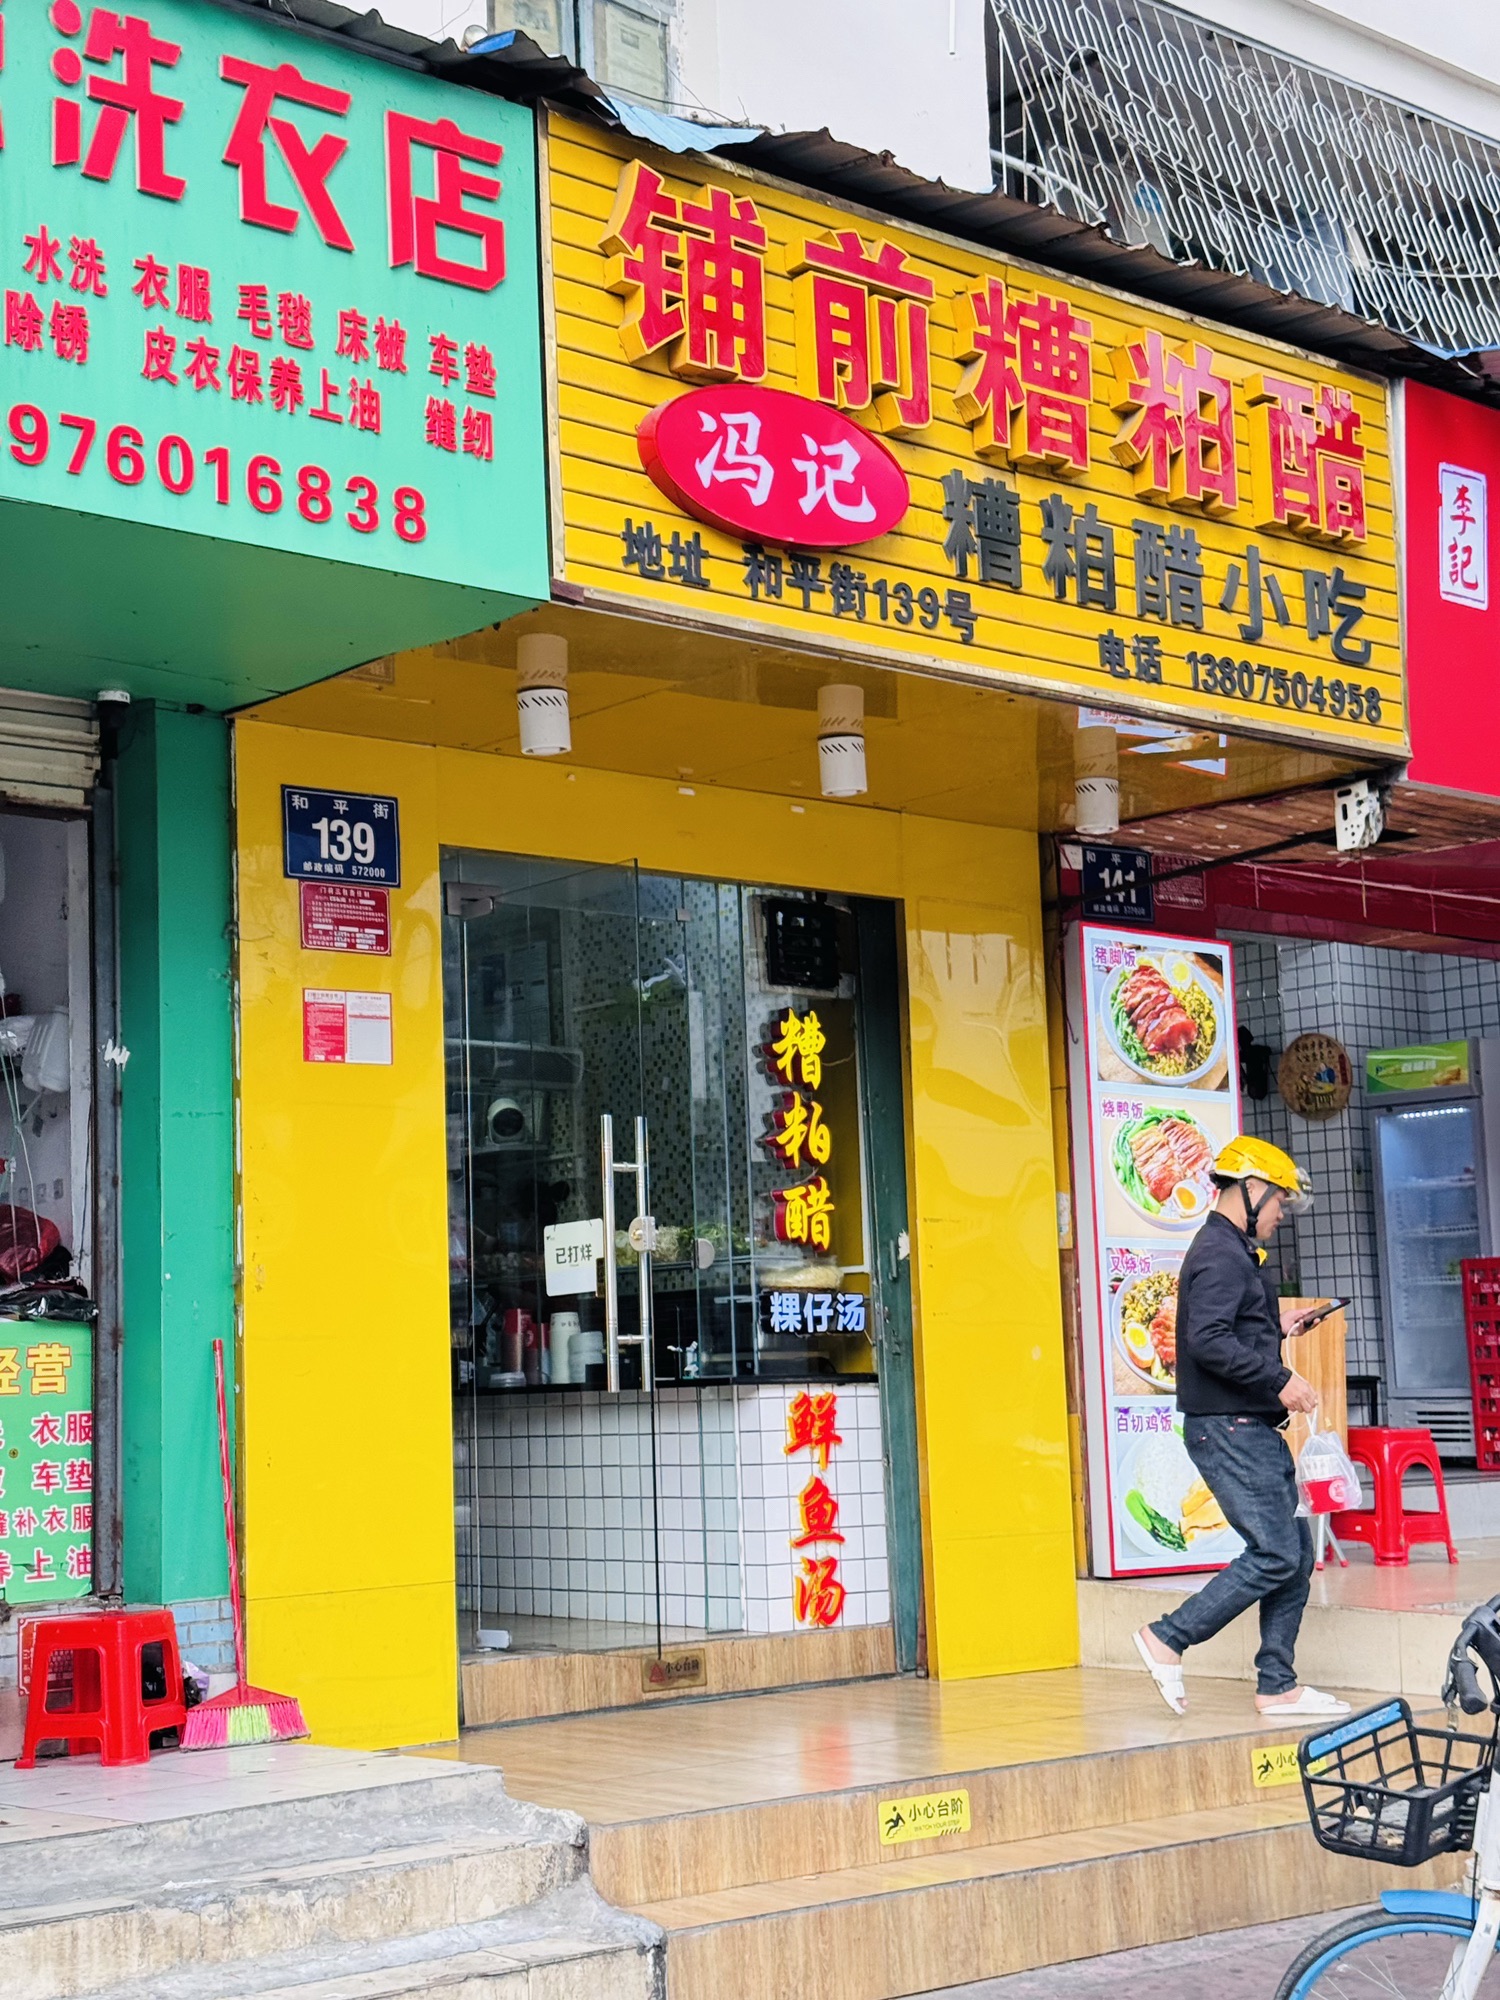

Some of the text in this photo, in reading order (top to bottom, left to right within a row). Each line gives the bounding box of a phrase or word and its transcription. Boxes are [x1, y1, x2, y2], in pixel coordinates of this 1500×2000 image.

[48, 0, 506, 292] 洗衣店
[23, 224, 498, 399] 水洗 衣服 毛毯 床被 车垫
[3, 290, 495, 462] 除锈 皮衣保养上油 缝纫
[600, 158, 1368, 548] 铺前糟粕醋
[7, 403, 428, 543] 976016838
[696, 410, 877, 522] 冯记
[941, 468, 1372, 667] 糟粕醋小吃
[1448, 485, 1479, 591] 李記
[620, 518, 978, 643] 地址 和平街139号
[1099, 628, 1383, 724] 电话 13807504958
[292, 794, 389, 820] 和平街
[312, 817, 375, 864] 139
[352, 865, 386, 879] 572000
[1094, 945, 1136, 968] 猪脚饭
[772, 1007, 836, 1251] 糟粕醋
[1101, 1098, 1144, 1121] 烧鸭饭
[555, 1243, 593, 1265] 已打烊
[1109, 1254, 1152, 1275] 叉烧饭
[769, 1291, 866, 1334] 粿仔汤
[31, 1413, 92, 1447] 衣服
[1116, 1413, 1174, 1434] 白切鸡饭
[32, 1459, 91, 1494] 车垫
[784, 1390, 846, 1627] 鲜鱼汤
[908, 1797, 963, 1822] 小心台阶
